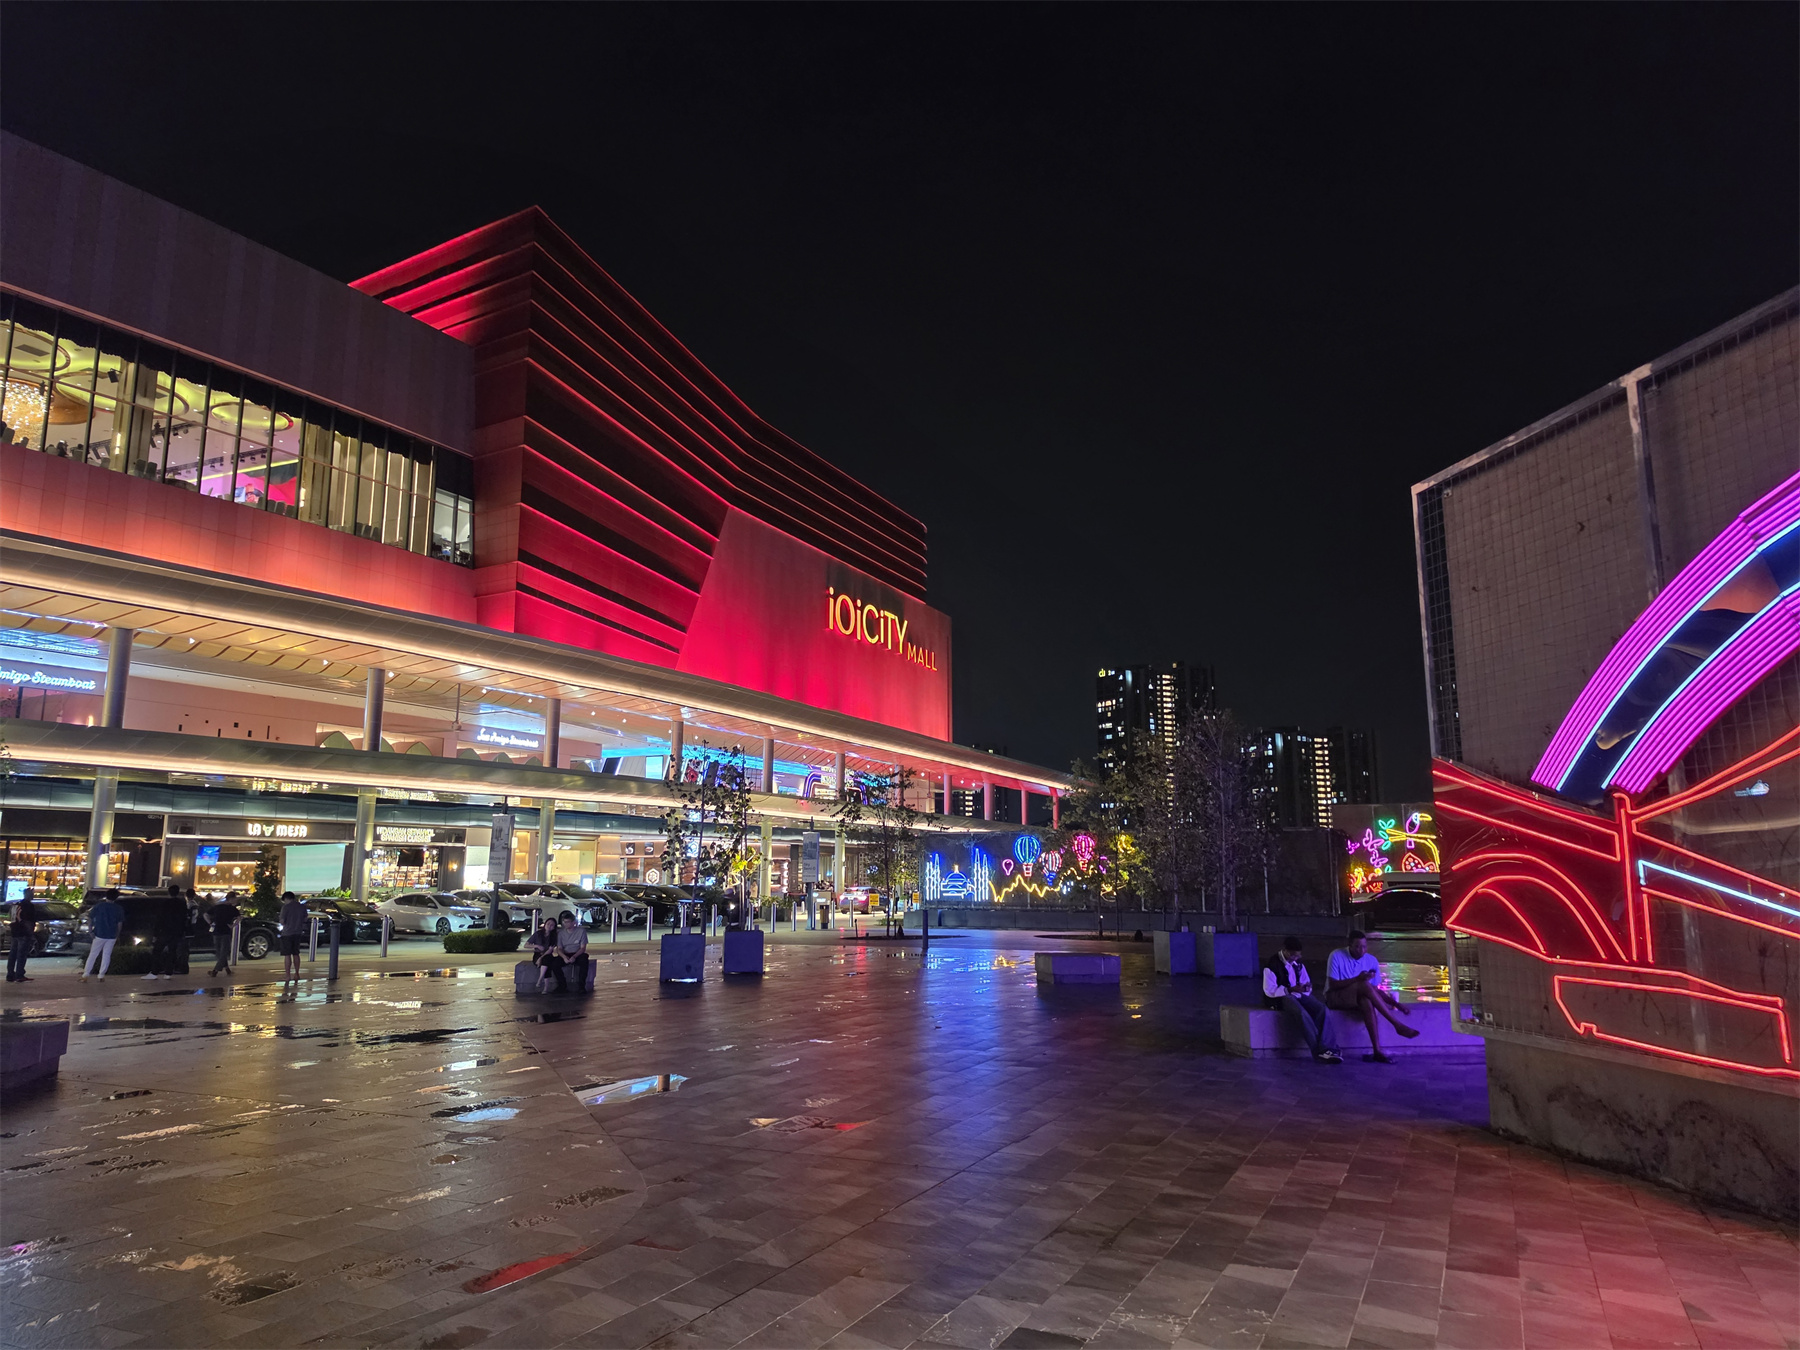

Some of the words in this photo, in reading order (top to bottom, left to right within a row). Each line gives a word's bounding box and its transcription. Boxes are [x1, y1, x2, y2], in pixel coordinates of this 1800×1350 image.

[907, 642, 938, 671] MALL
[31, 671, 97, 690] Steamboat
[247, 822, 262, 837] LA
[276, 824, 308, 838] MESA
